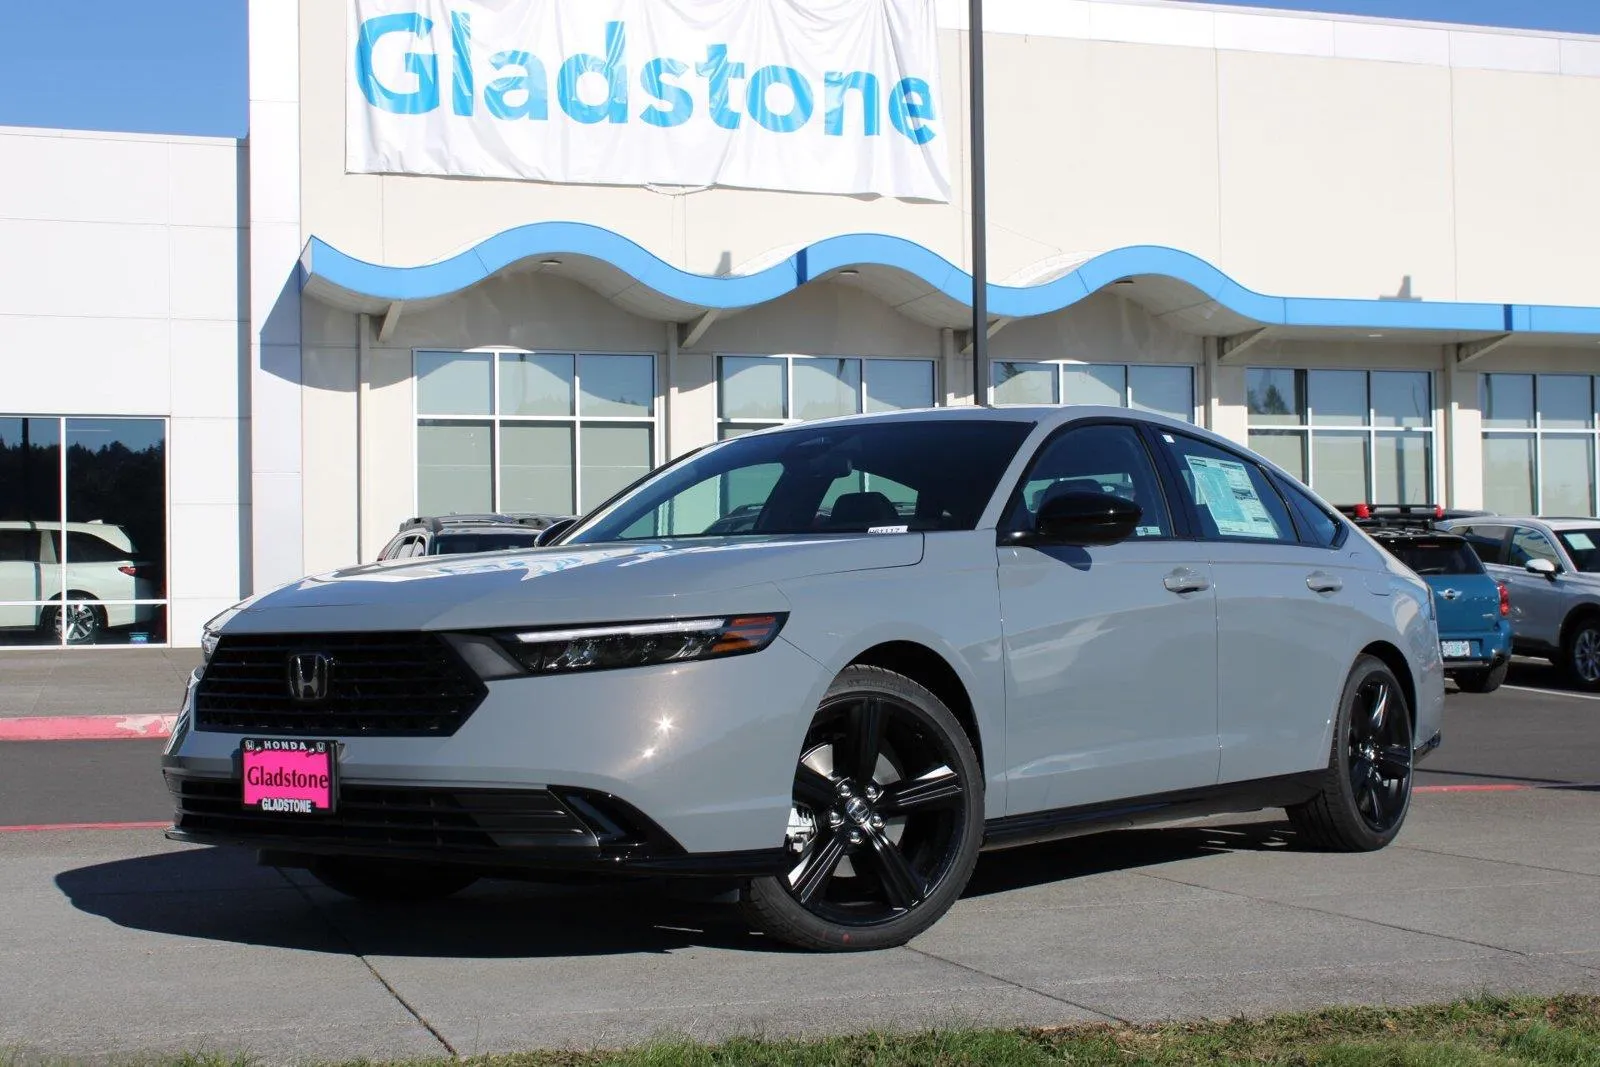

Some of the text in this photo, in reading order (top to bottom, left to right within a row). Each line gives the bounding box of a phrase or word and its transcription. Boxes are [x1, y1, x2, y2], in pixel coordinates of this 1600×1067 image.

[355, 11, 936, 145] Gladstone
[263, 740, 308, 750] HONDA
[247, 765, 328, 789] Gladstone
[261, 797, 312, 813] GLADSTONE
